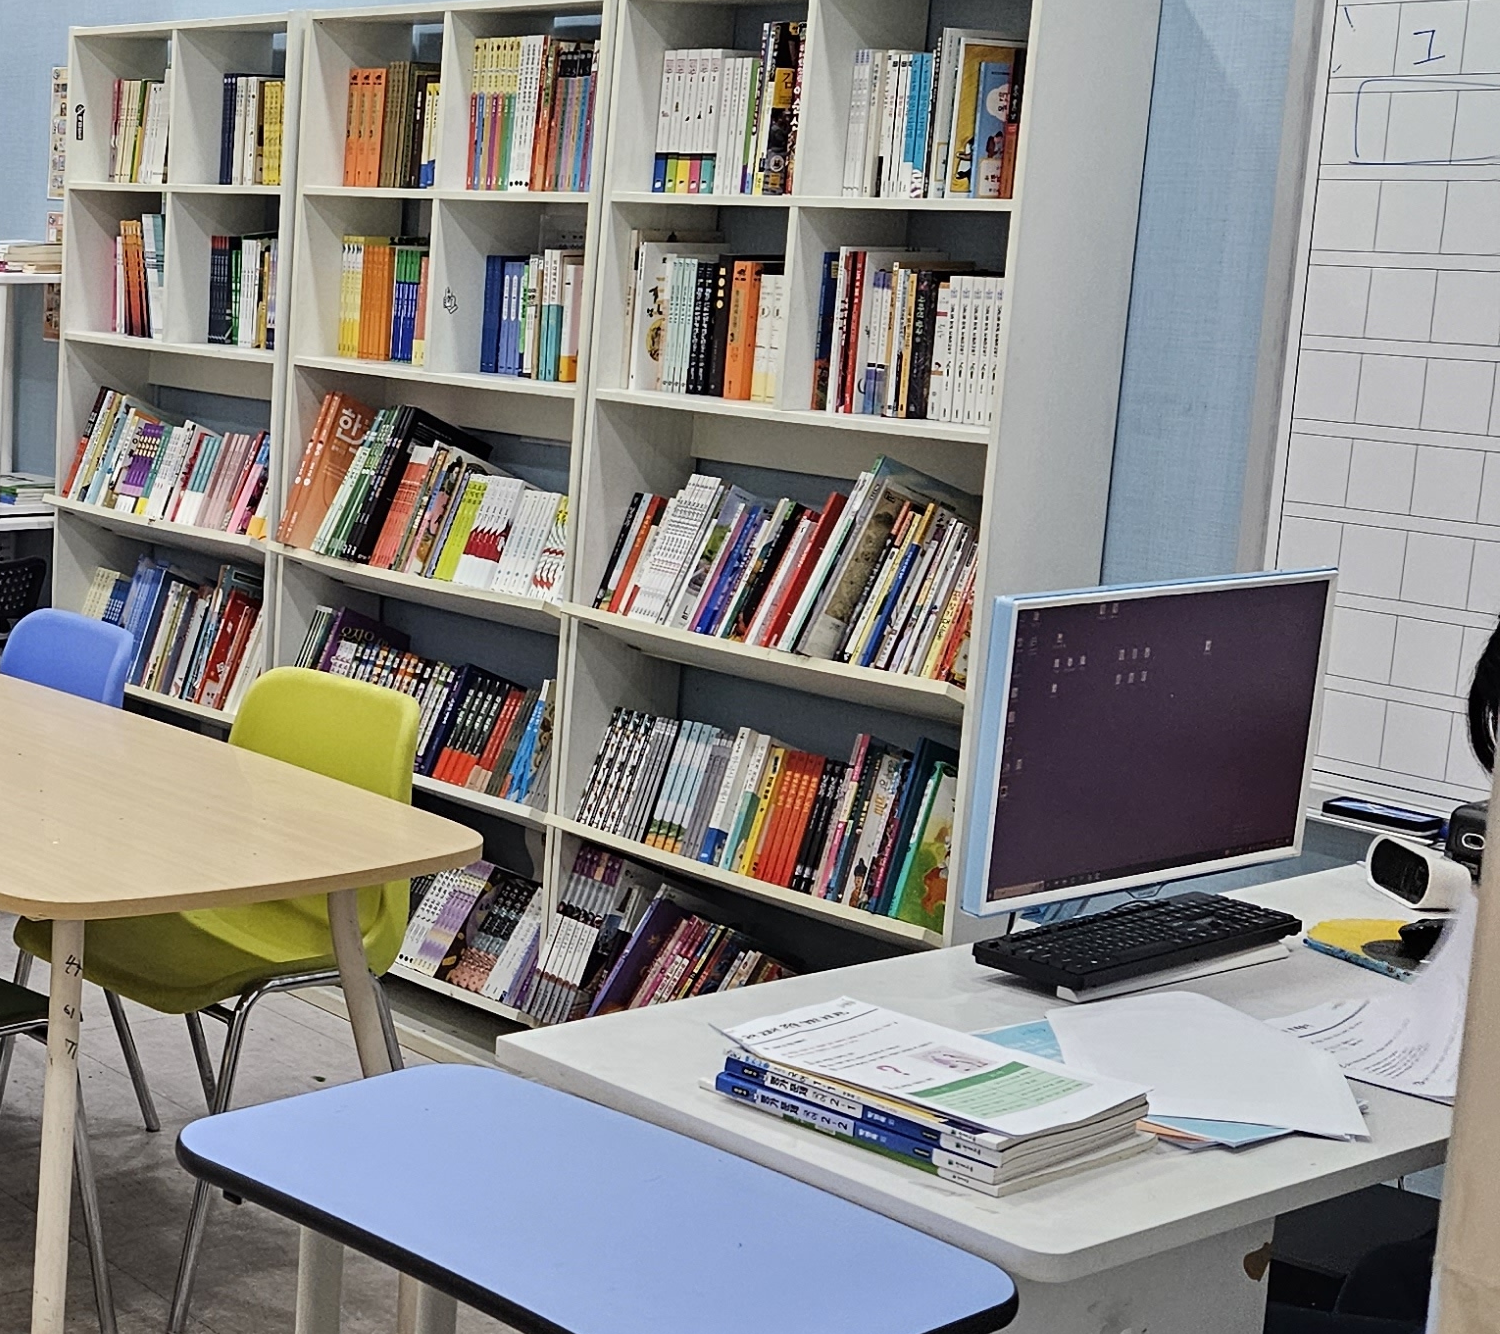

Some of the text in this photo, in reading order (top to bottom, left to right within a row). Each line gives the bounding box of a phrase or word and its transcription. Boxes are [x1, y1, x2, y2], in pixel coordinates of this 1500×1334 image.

[789, 1082, 808, 1096] 문제
[829, 1098, 856, 1110] 2-1
[780, 1101, 800, 1115] 문제
[820, 1117, 848, 1130] 2-2
